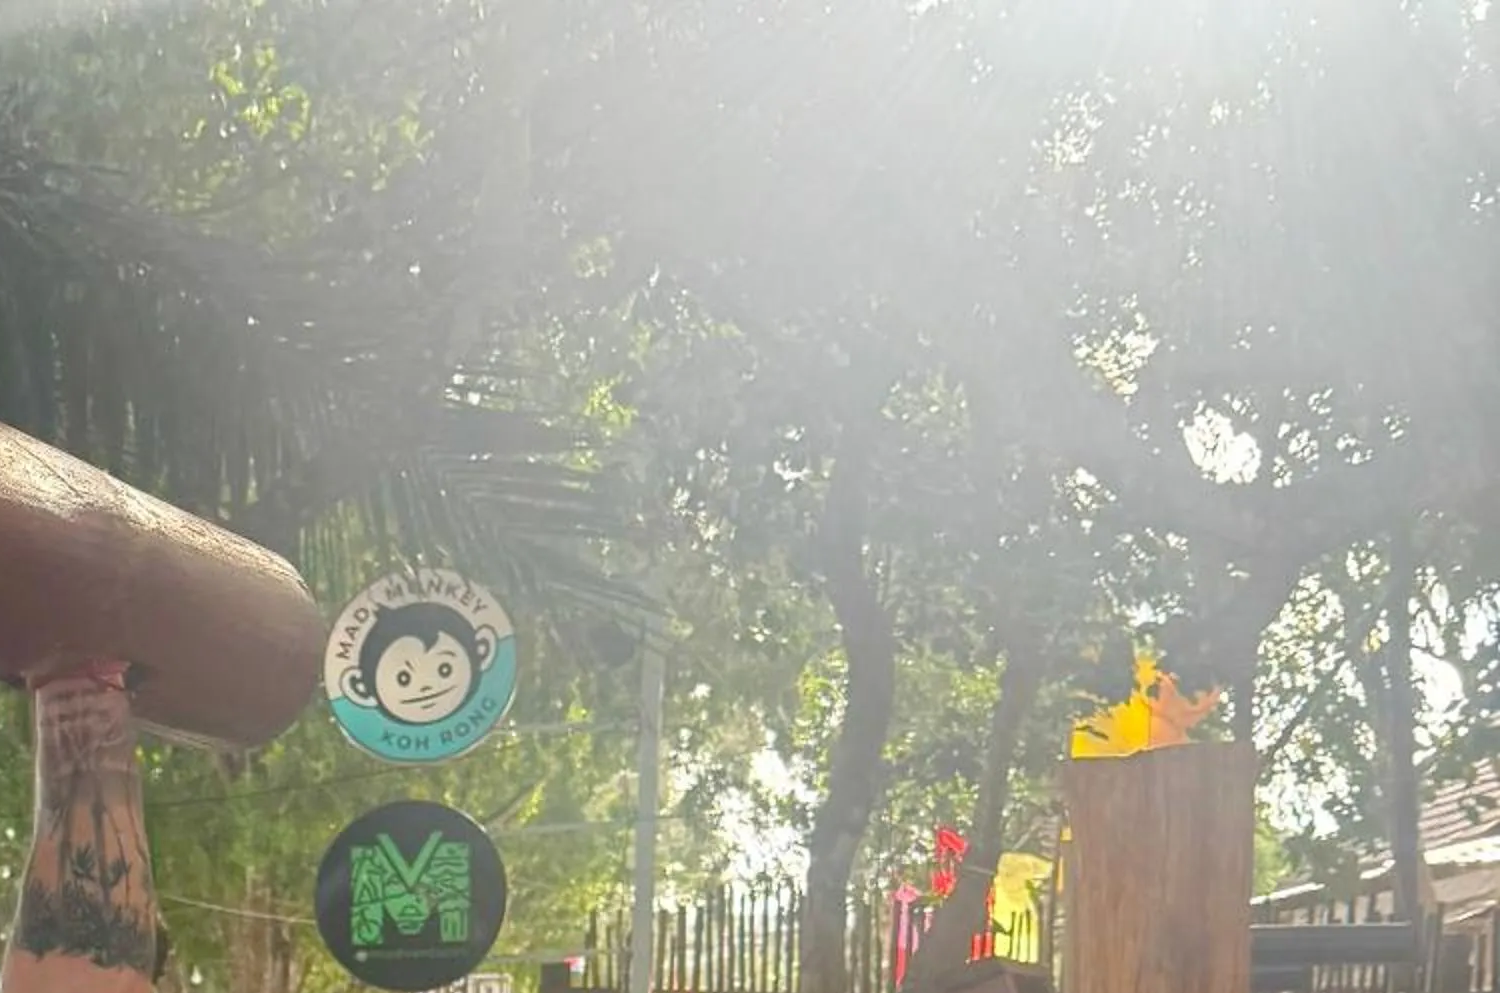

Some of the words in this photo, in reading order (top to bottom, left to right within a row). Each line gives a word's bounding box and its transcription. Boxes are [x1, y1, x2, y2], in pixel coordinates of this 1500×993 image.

[336, 606, 371, 661] MAD
[383, 576, 489, 614] MNKEY
[381, 728, 431, 752] KOH
[439, 694, 497, 746] RONG
